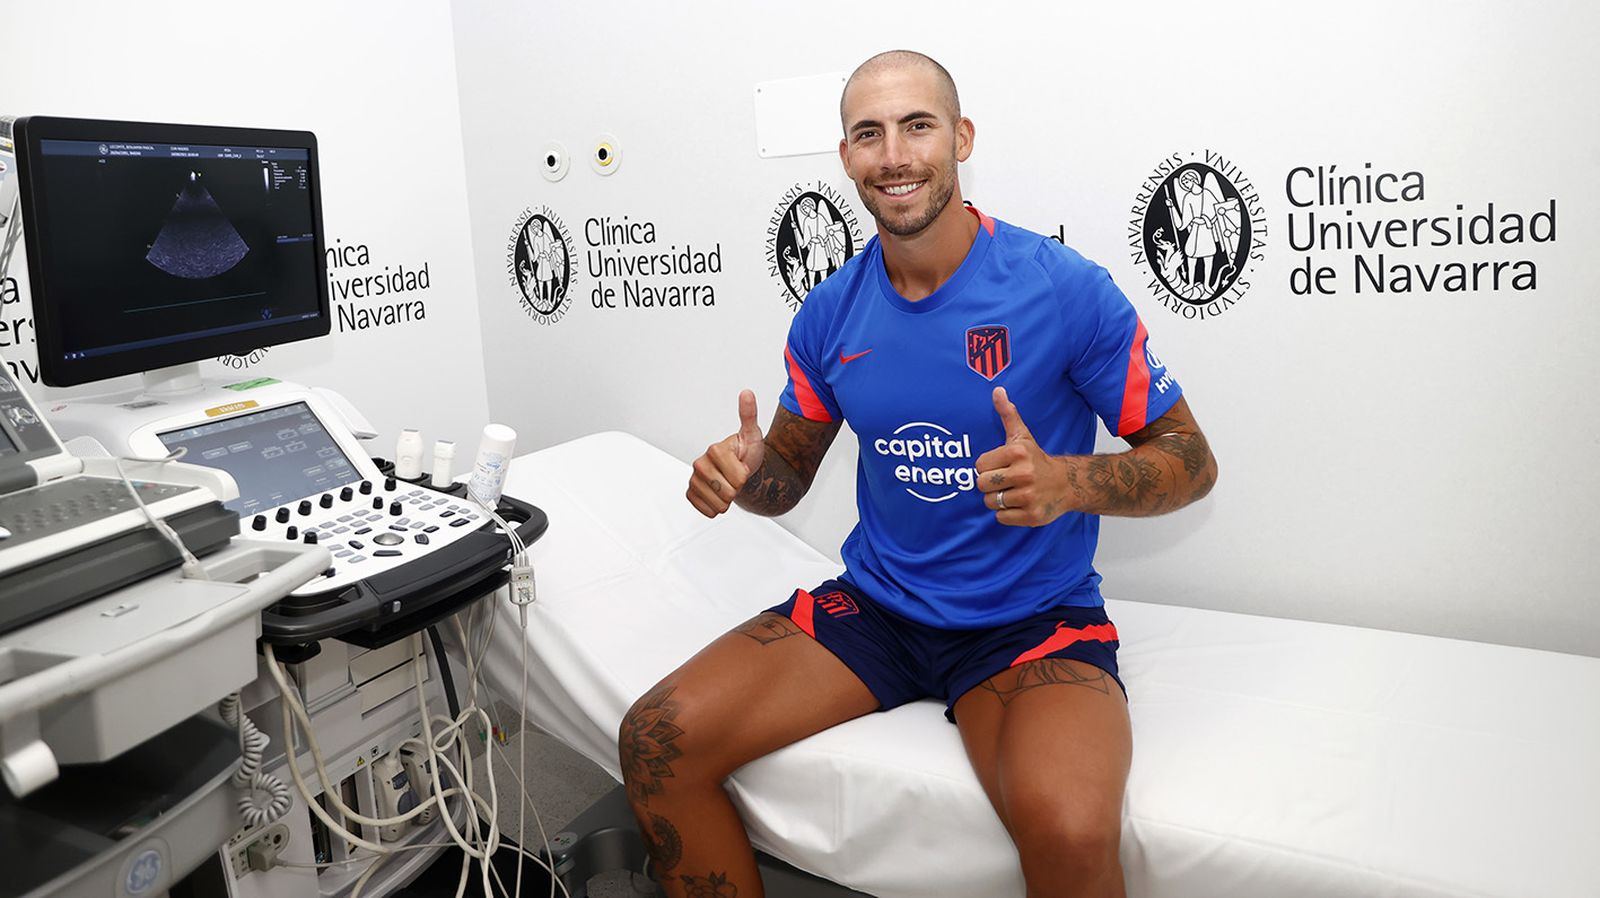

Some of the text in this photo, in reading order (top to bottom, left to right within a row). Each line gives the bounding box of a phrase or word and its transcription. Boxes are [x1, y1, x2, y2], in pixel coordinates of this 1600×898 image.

[1286, 163, 1425, 208] Clínica
[1127, 152, 1183, 266] NAVARRENSIS
[1204, 149, 1268, 262] VNIVERSITAS
[584, 215, 656, 247] Clínica
[765, 182, 803, 278] NAVARRENSIS
[1288, 199, 1556, 252] Universidad
[325, 238, 370, 269] nica
[587, 243, 722, 278] Universidad
[329, 262, 430, 301] iversidad
[591, 280, 715, 309] de Navarra
[1290, 254, 1537, 296] de Navarra
[337, 300, 426, 333] Navarra
[1146, 276, 1251, 320] STVDIORVM
[874, 433, 971, 462] capital
[894, 465, 981, 491] energ
